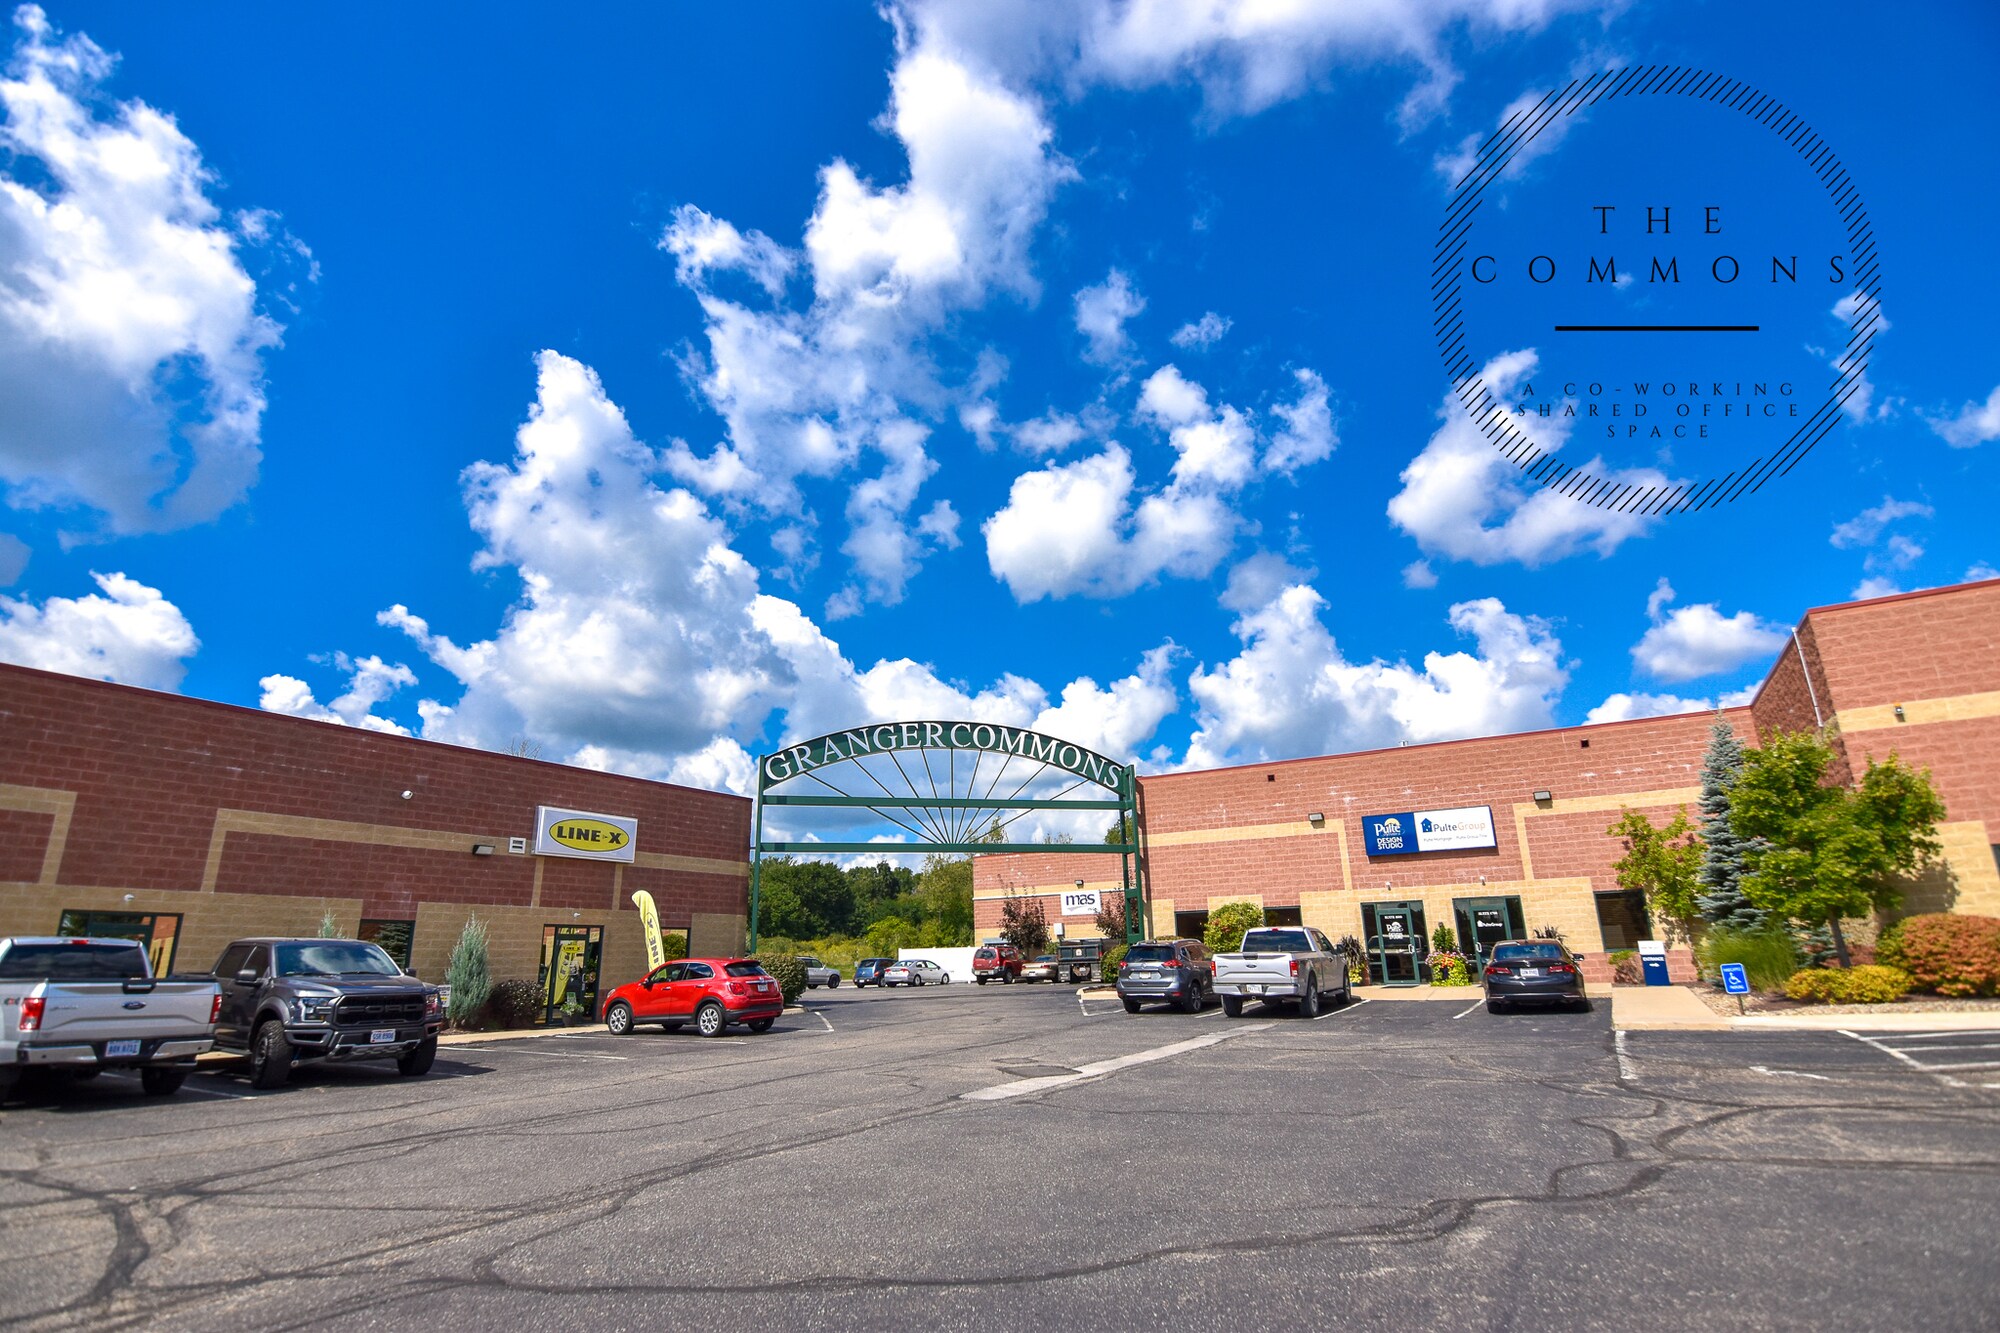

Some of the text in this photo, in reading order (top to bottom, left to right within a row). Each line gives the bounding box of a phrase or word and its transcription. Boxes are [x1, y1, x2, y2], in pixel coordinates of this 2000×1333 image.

[765, 721, 1124, 790] GRANGER COMMONS
[556, 825, 622, 845] LINE-X
[1377, 836, 1403, 844] DESIGN
[1378, 842, 1404, 850] STUDIO
[1065, 893, 1096, 906] mas
